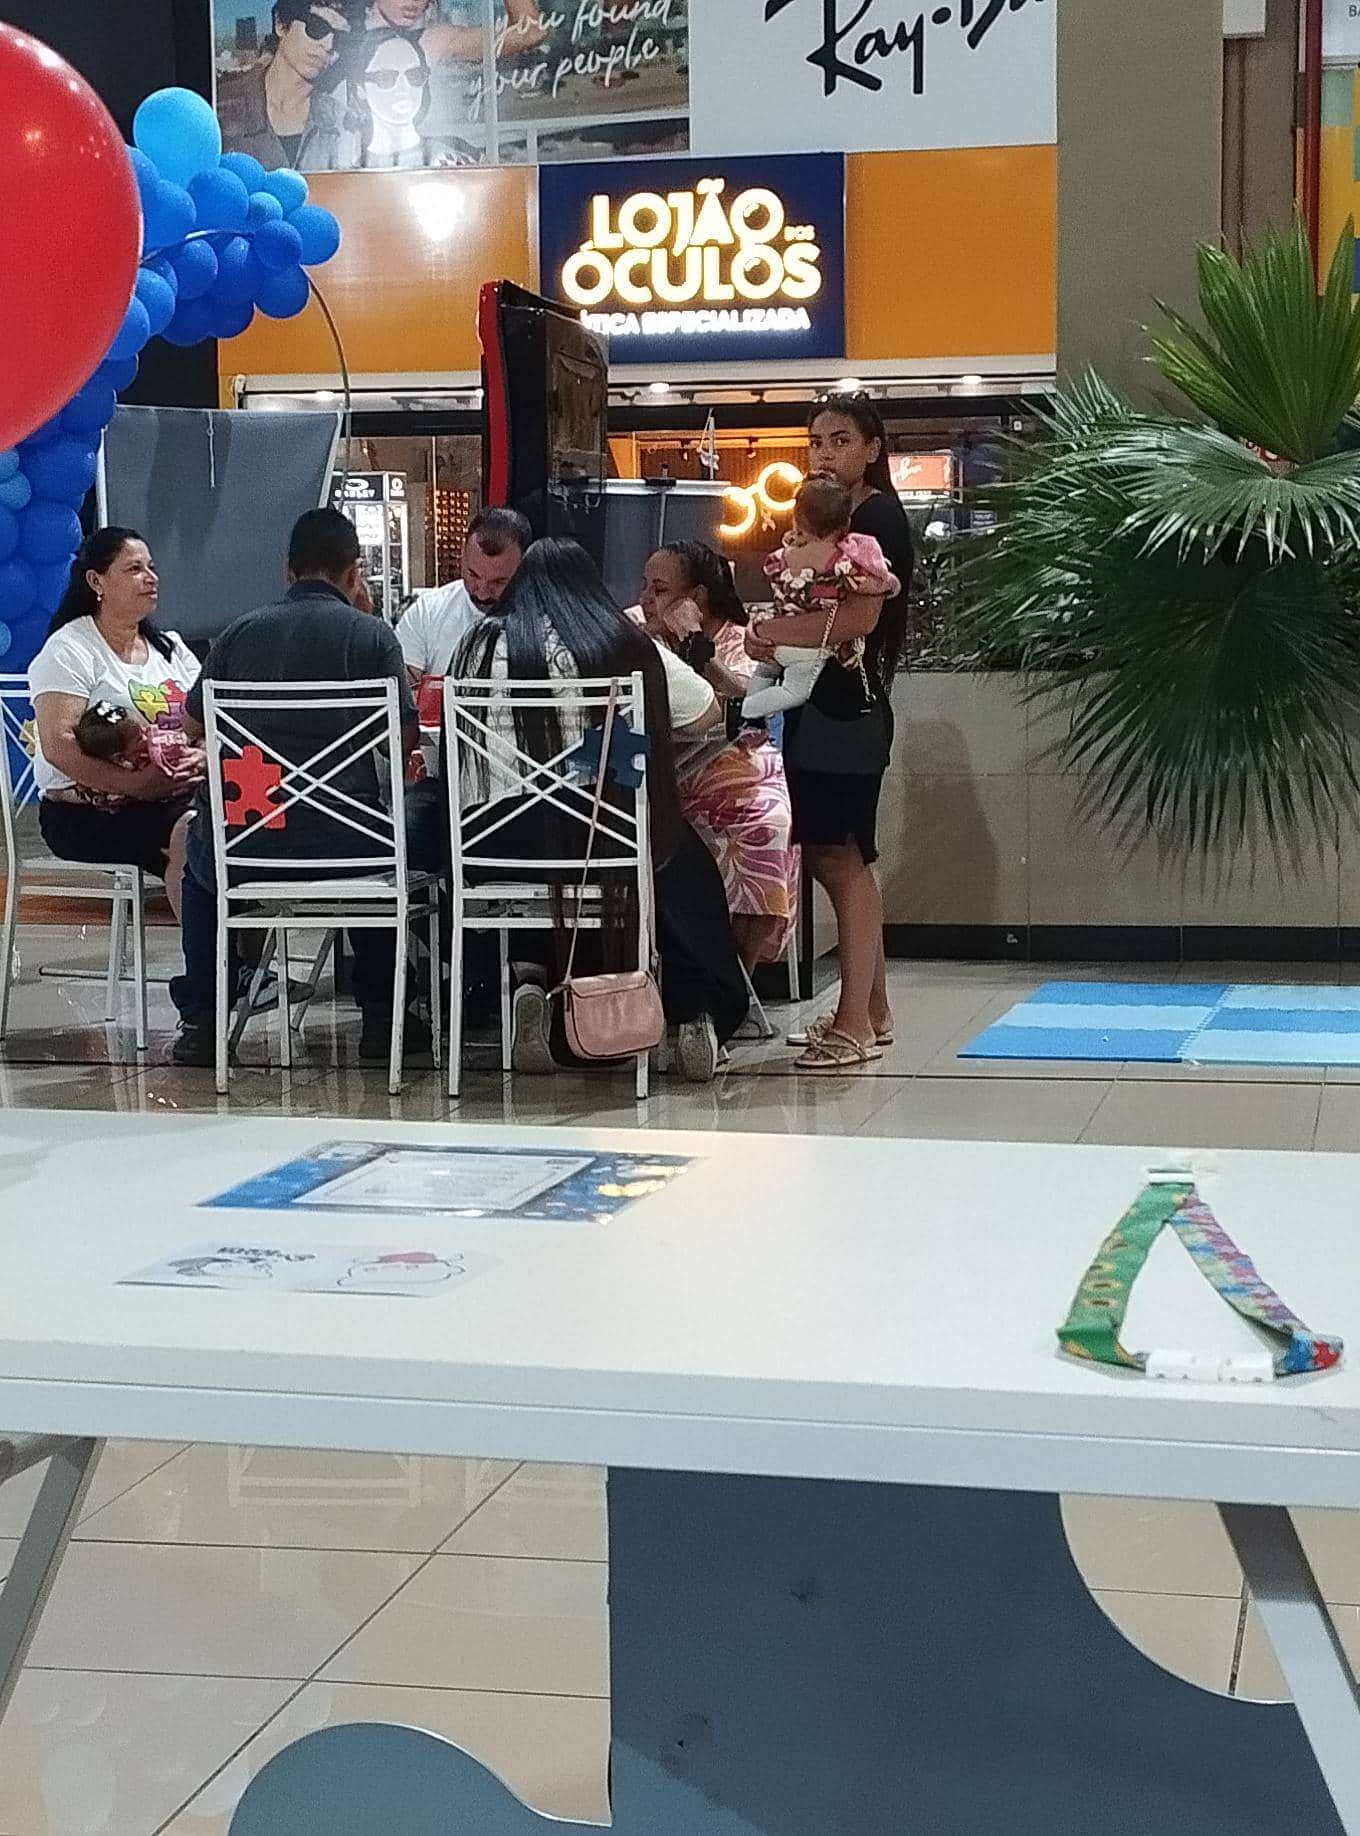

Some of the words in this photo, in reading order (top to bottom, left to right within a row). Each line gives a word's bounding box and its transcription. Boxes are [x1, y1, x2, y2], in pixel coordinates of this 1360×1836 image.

[495, 12, 565, 58] you
[570, 0, 670, 45] found
[466, 63, 549, 122] your
[552, 26, 660, 99] people
[591, 178, 785, 257] LOJÃO
[561, 240, 822, 305] ÓCULOS
[641, 306, 812, 334] ESPECIALIZADA
